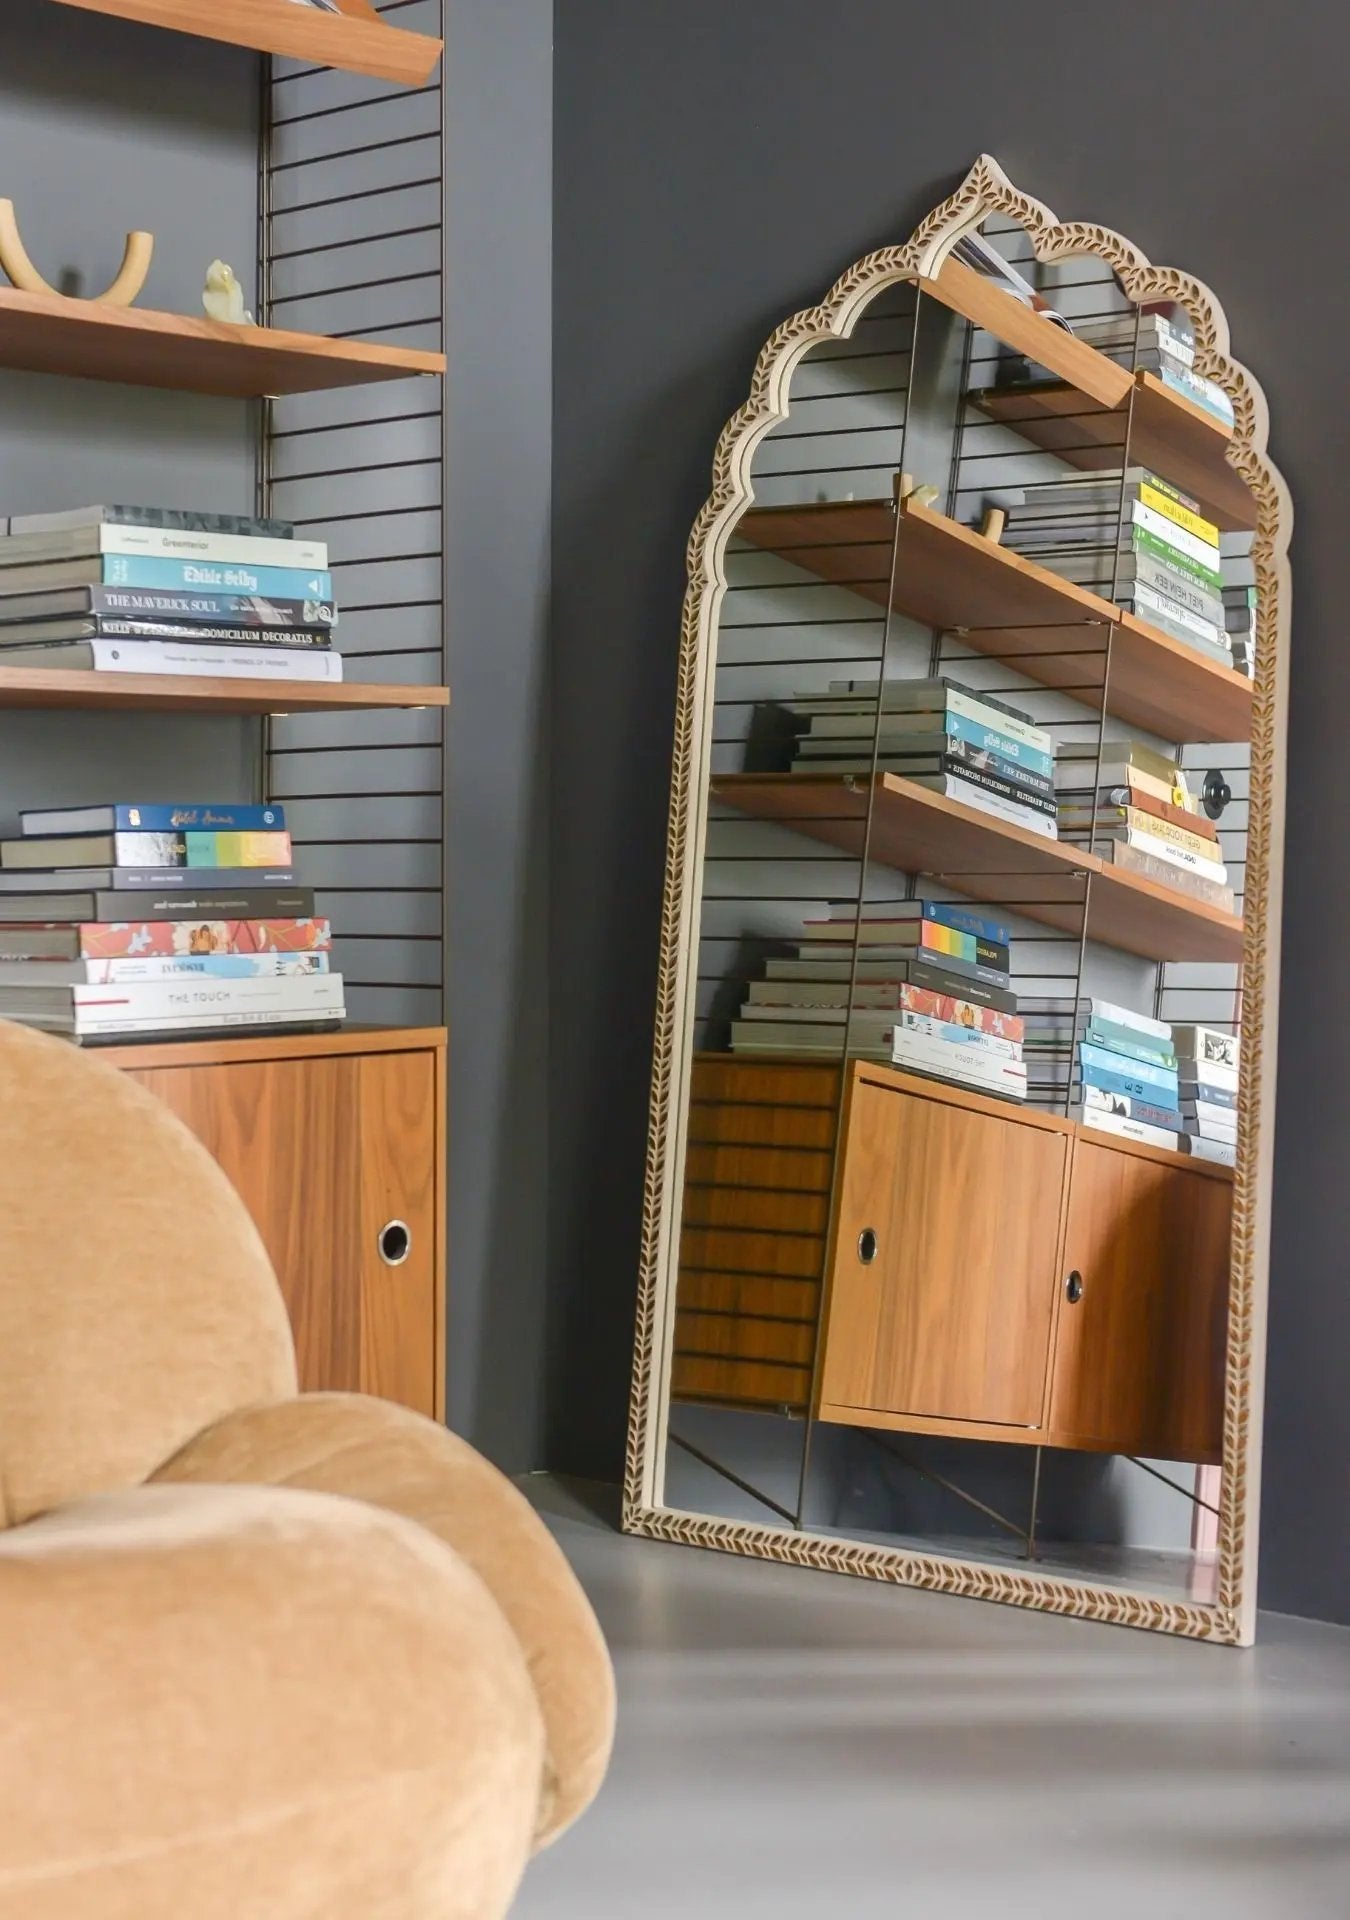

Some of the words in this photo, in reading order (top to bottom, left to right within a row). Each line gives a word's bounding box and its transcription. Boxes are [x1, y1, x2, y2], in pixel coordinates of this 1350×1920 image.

[104, 594, 131, 607] THE
[132, 596, 191, 611] MAVERICK
[191, 600, 221, 613] SOUL
[262, 631, 313, 643] DECORATUS
[168, 993, 190, 1004] THE
[193, 991, 232, 1003] TOUCH
